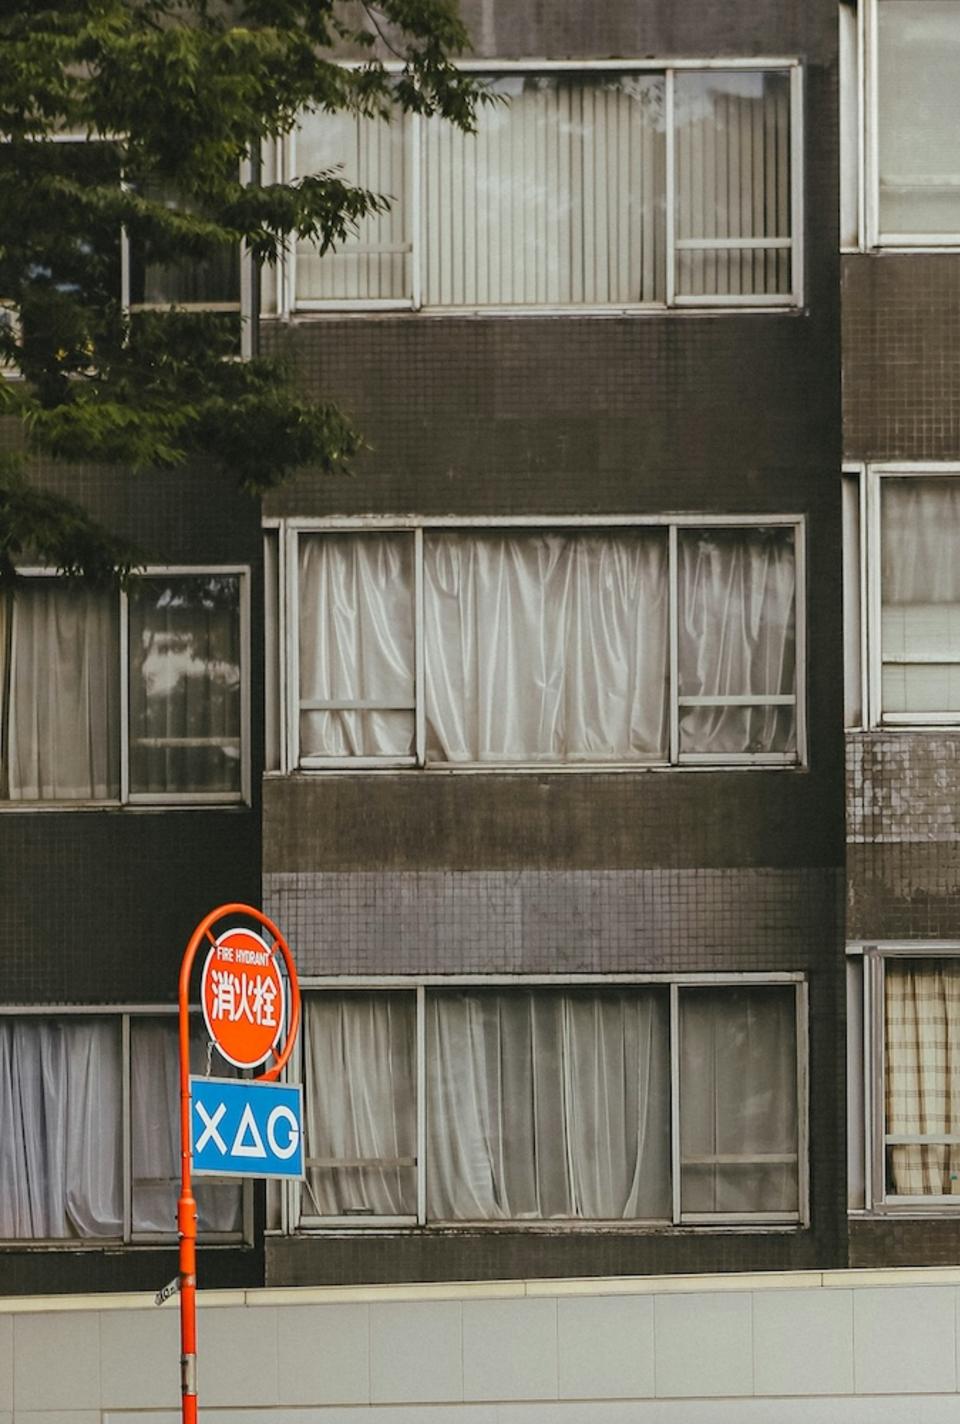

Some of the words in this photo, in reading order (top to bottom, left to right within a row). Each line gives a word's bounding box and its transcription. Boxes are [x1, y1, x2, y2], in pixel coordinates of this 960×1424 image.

[217, 946, 234, 962] FIRE
[235, 948, 269, 967] HYDRANT
[211, 969, 277, 1026] 消火栓
